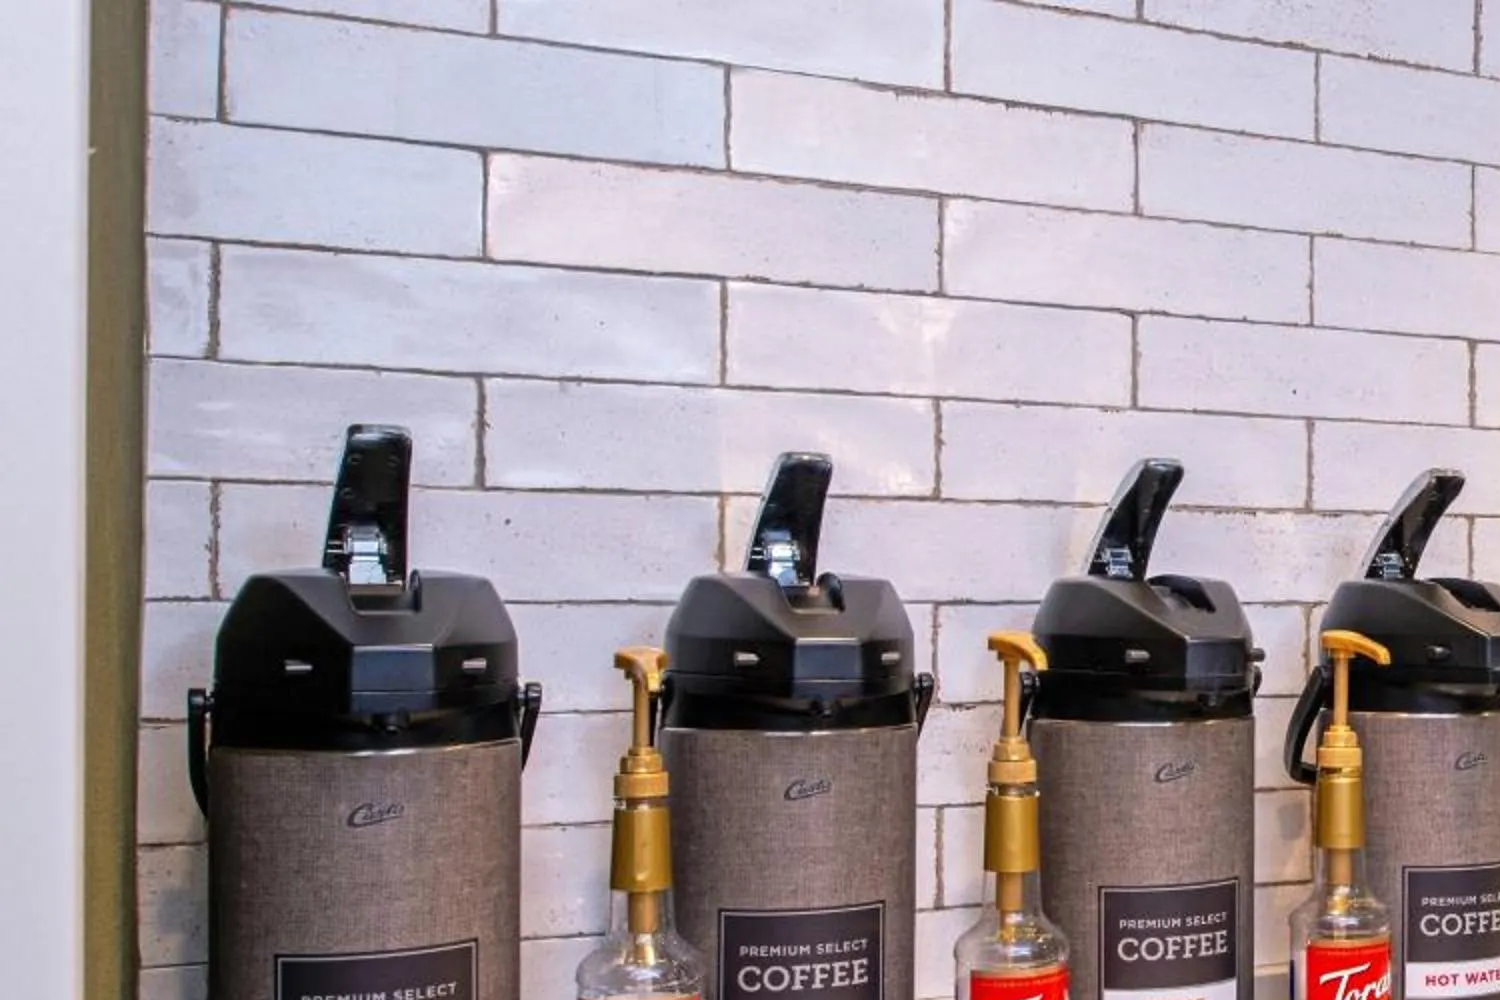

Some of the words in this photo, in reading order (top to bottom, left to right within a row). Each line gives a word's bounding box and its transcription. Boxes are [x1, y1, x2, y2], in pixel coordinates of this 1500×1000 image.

[1421, 895, 1477, 907] PREMIUM
[1119, 917, 1181, 930] PREMIUM
[1186, 911, 1228, 928] SELECT
[739, 944, 811, 958] PREMIUM
[815, 938, 869, 956] SELECT
[1117, 930, 1228, 962] COFFEE
[737, 958, 869, 992] COFFEE
[1425, 973, 1460, 987] HOT
